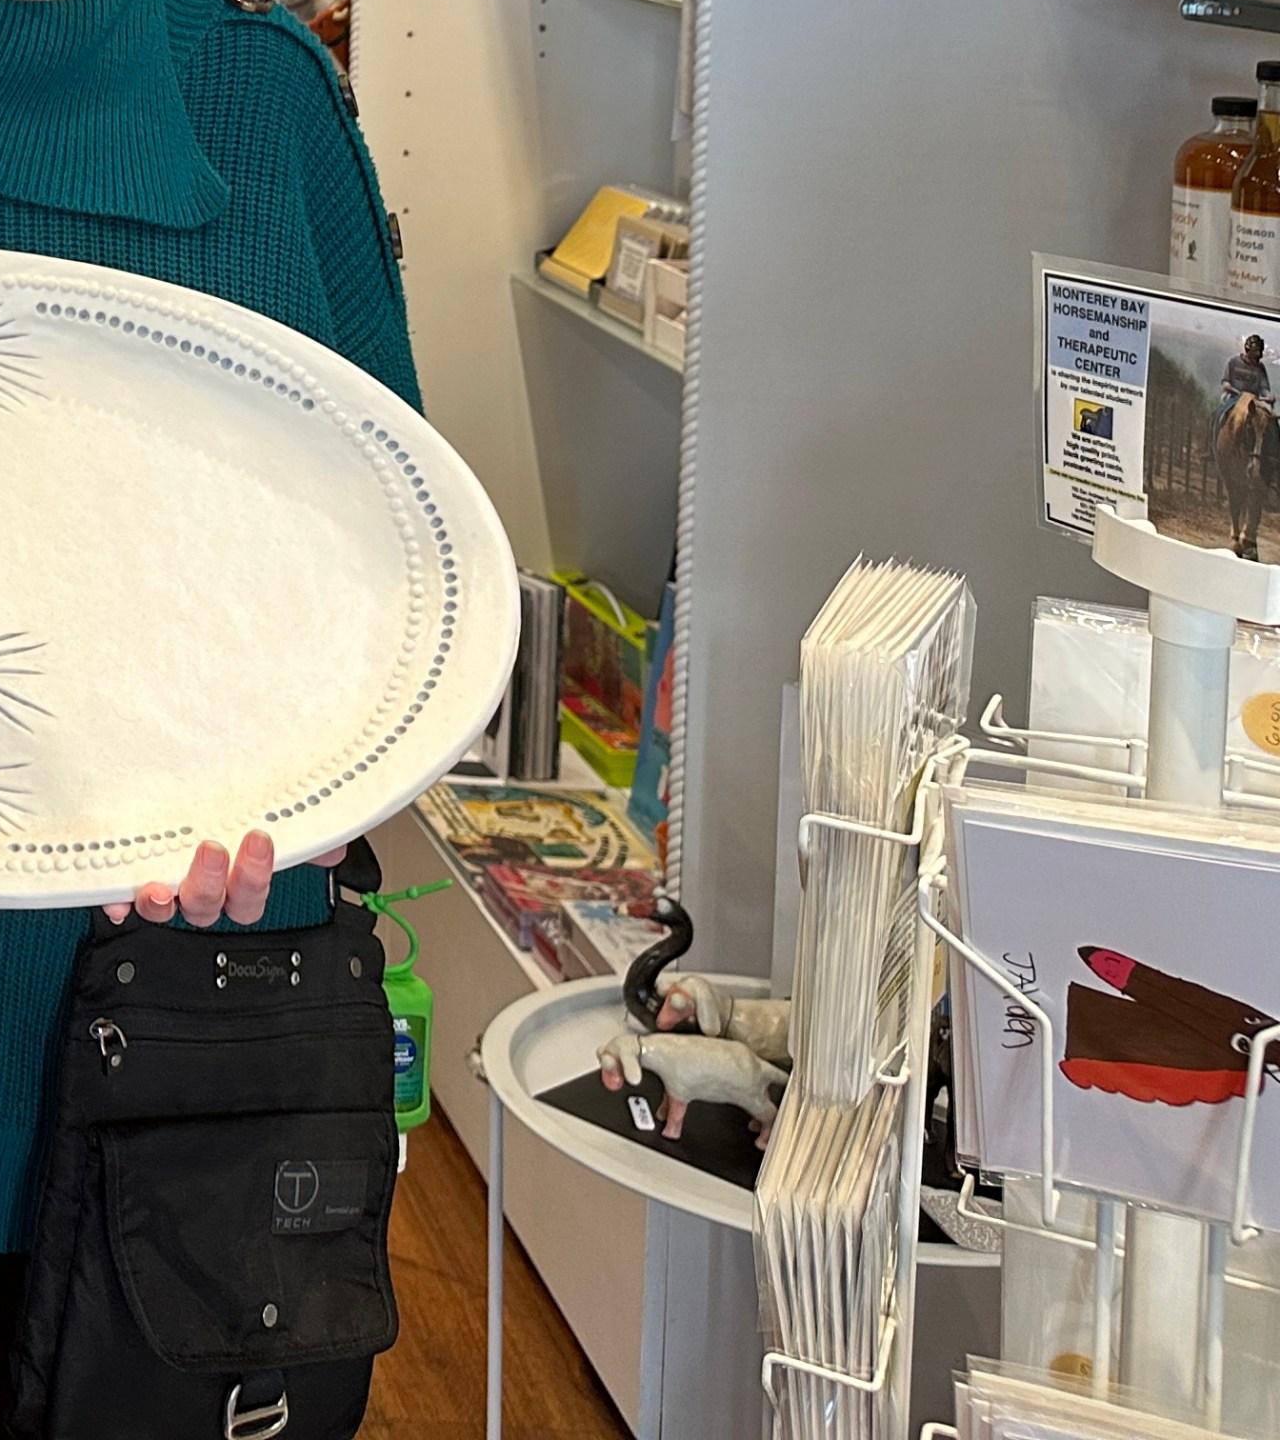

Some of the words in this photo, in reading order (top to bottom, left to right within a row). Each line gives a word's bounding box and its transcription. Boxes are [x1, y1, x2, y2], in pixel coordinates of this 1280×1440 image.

[1052, 285, 1118, 309] MONTEREY
[1121, 299, 1145, 314] BAY
[1054, 303, 1147, 331] HORSEMANSHIP
[1089, 329, 1109, 341] and
[1057, 336, 1137, 365] THERAPEUTIC
[1075, 357, 1120, 378] CENTER
[1058, 371, 1080, 383] sharing
[1082, 375, 1091, 384] the
[1092, 379, 1118, 393] inspiring
[1120, 385, 1143, 397] artwork
[1060, 382, 1067, 390] by
[1081, 385, 1104, 399] talented
[1106, 393, 1132, 406] students
[1067, 440, 1079, 450] high
[1081, 445, 1099, 457] quality
[1082, 435, 1091, 443] are
[1093, 436, 1116, 452] offering
[1063, 449, 1079, 459] blank
[1081, 454, 1104, 468] greeting
[1095, 470, 1105, 478] and
[275, 1217, 311, 1228] TECH
